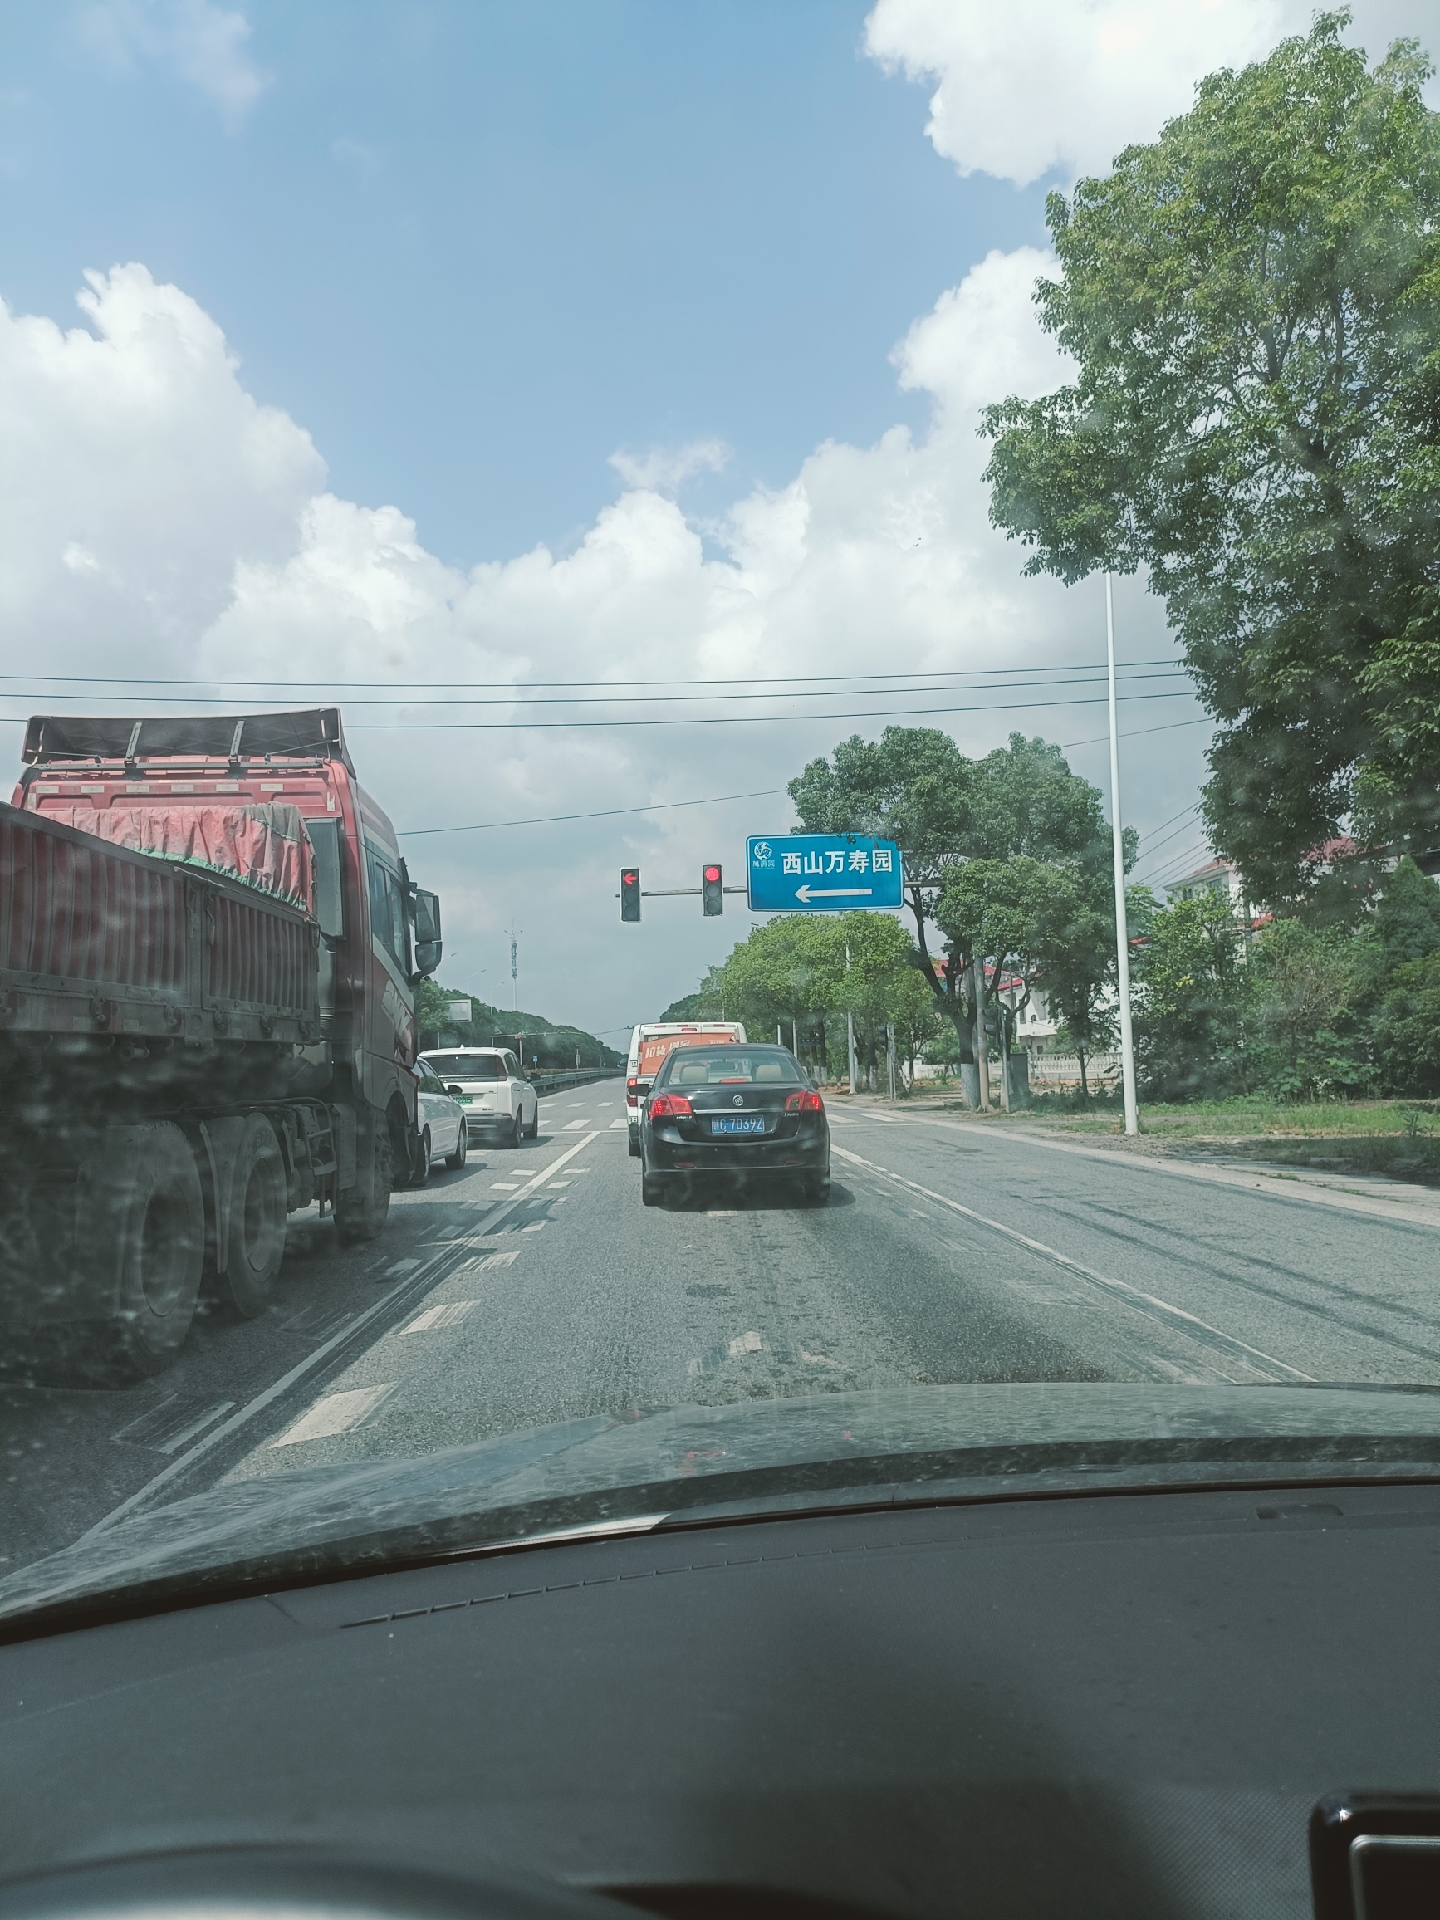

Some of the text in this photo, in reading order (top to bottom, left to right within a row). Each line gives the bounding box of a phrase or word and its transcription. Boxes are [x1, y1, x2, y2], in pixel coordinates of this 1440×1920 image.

[781, 850, 892, 874] 西山万寿园
